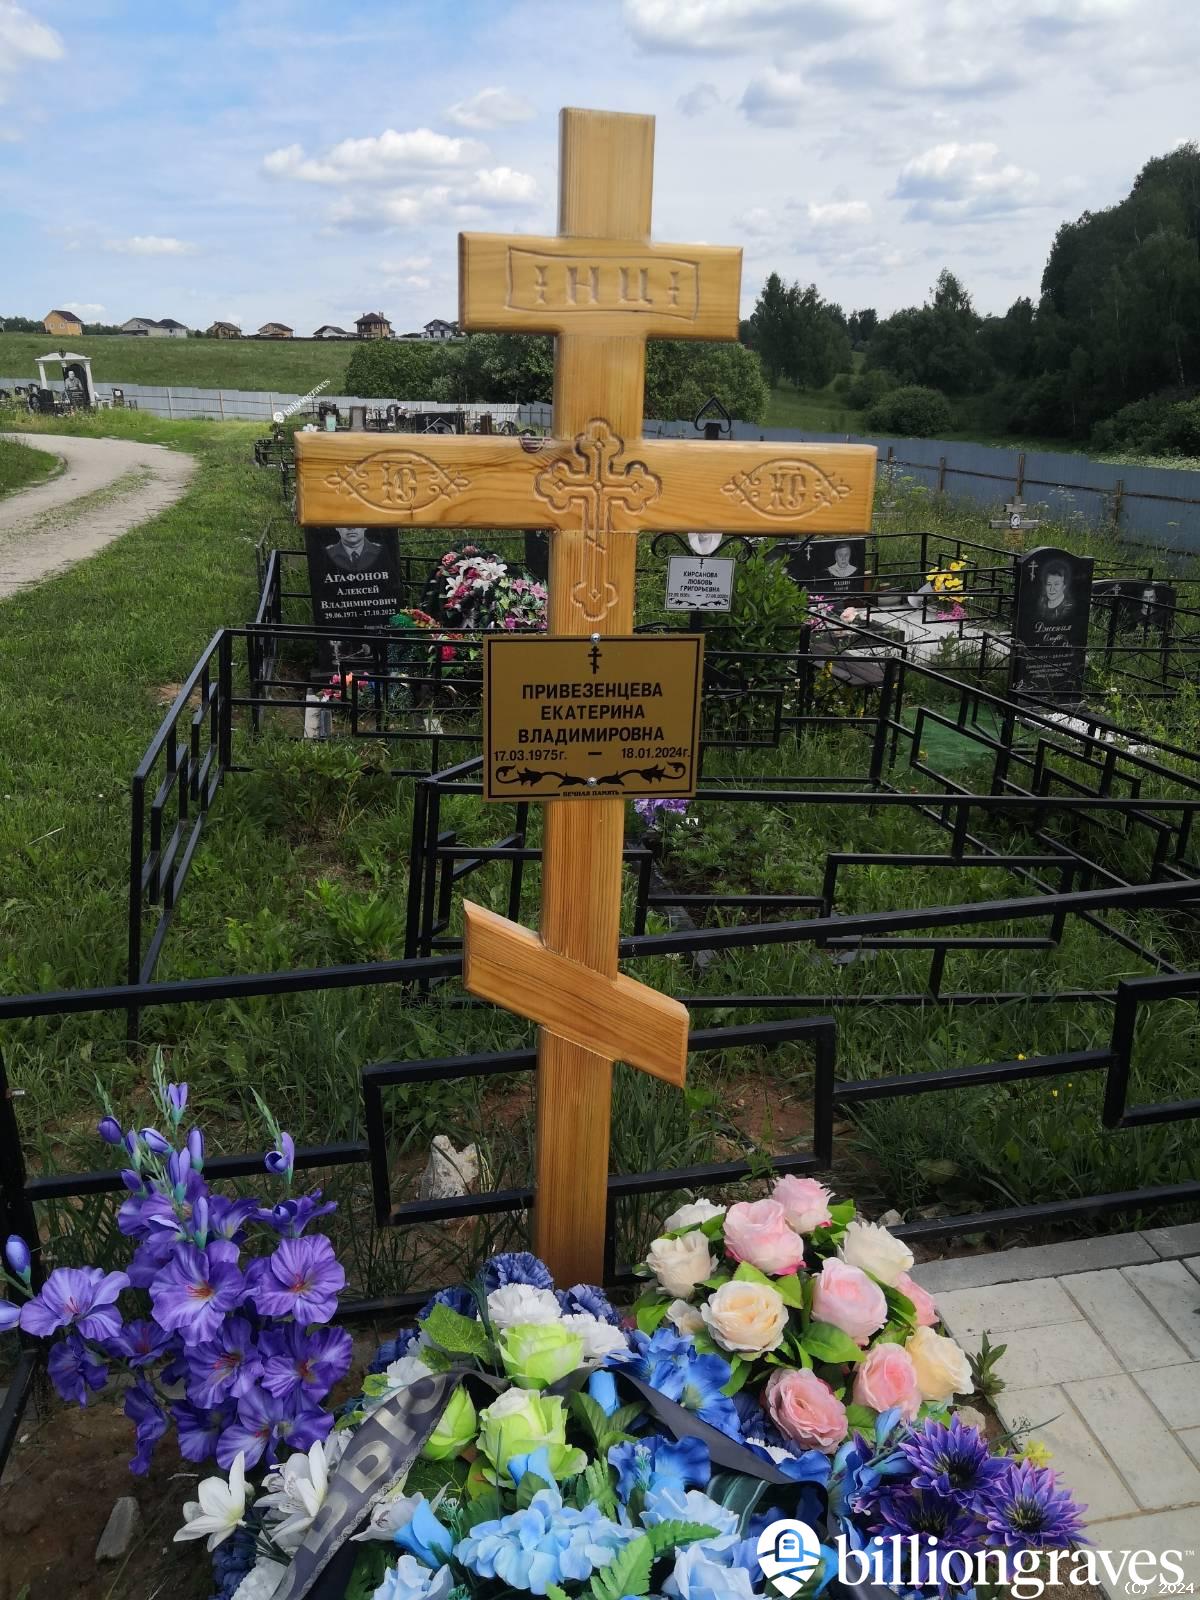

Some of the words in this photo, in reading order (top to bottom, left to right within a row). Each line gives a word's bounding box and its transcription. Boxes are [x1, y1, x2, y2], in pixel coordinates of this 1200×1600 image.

[325, 611, 358, 620] 29.06.1971
[363, 608, 396, 617] 17.10.2022
[522, 682, 663, 700] ПРИВЕЗЕНЦЕВА
[540, 704, 645, 721] ЕКАТЕРИНА
[518, 726, 665, 745] ВЛАДИМИРОВНА
[494, 749, 568, 762] 17.03.1975г.
[621, 746, 691, 759] 18.01.2024г.
